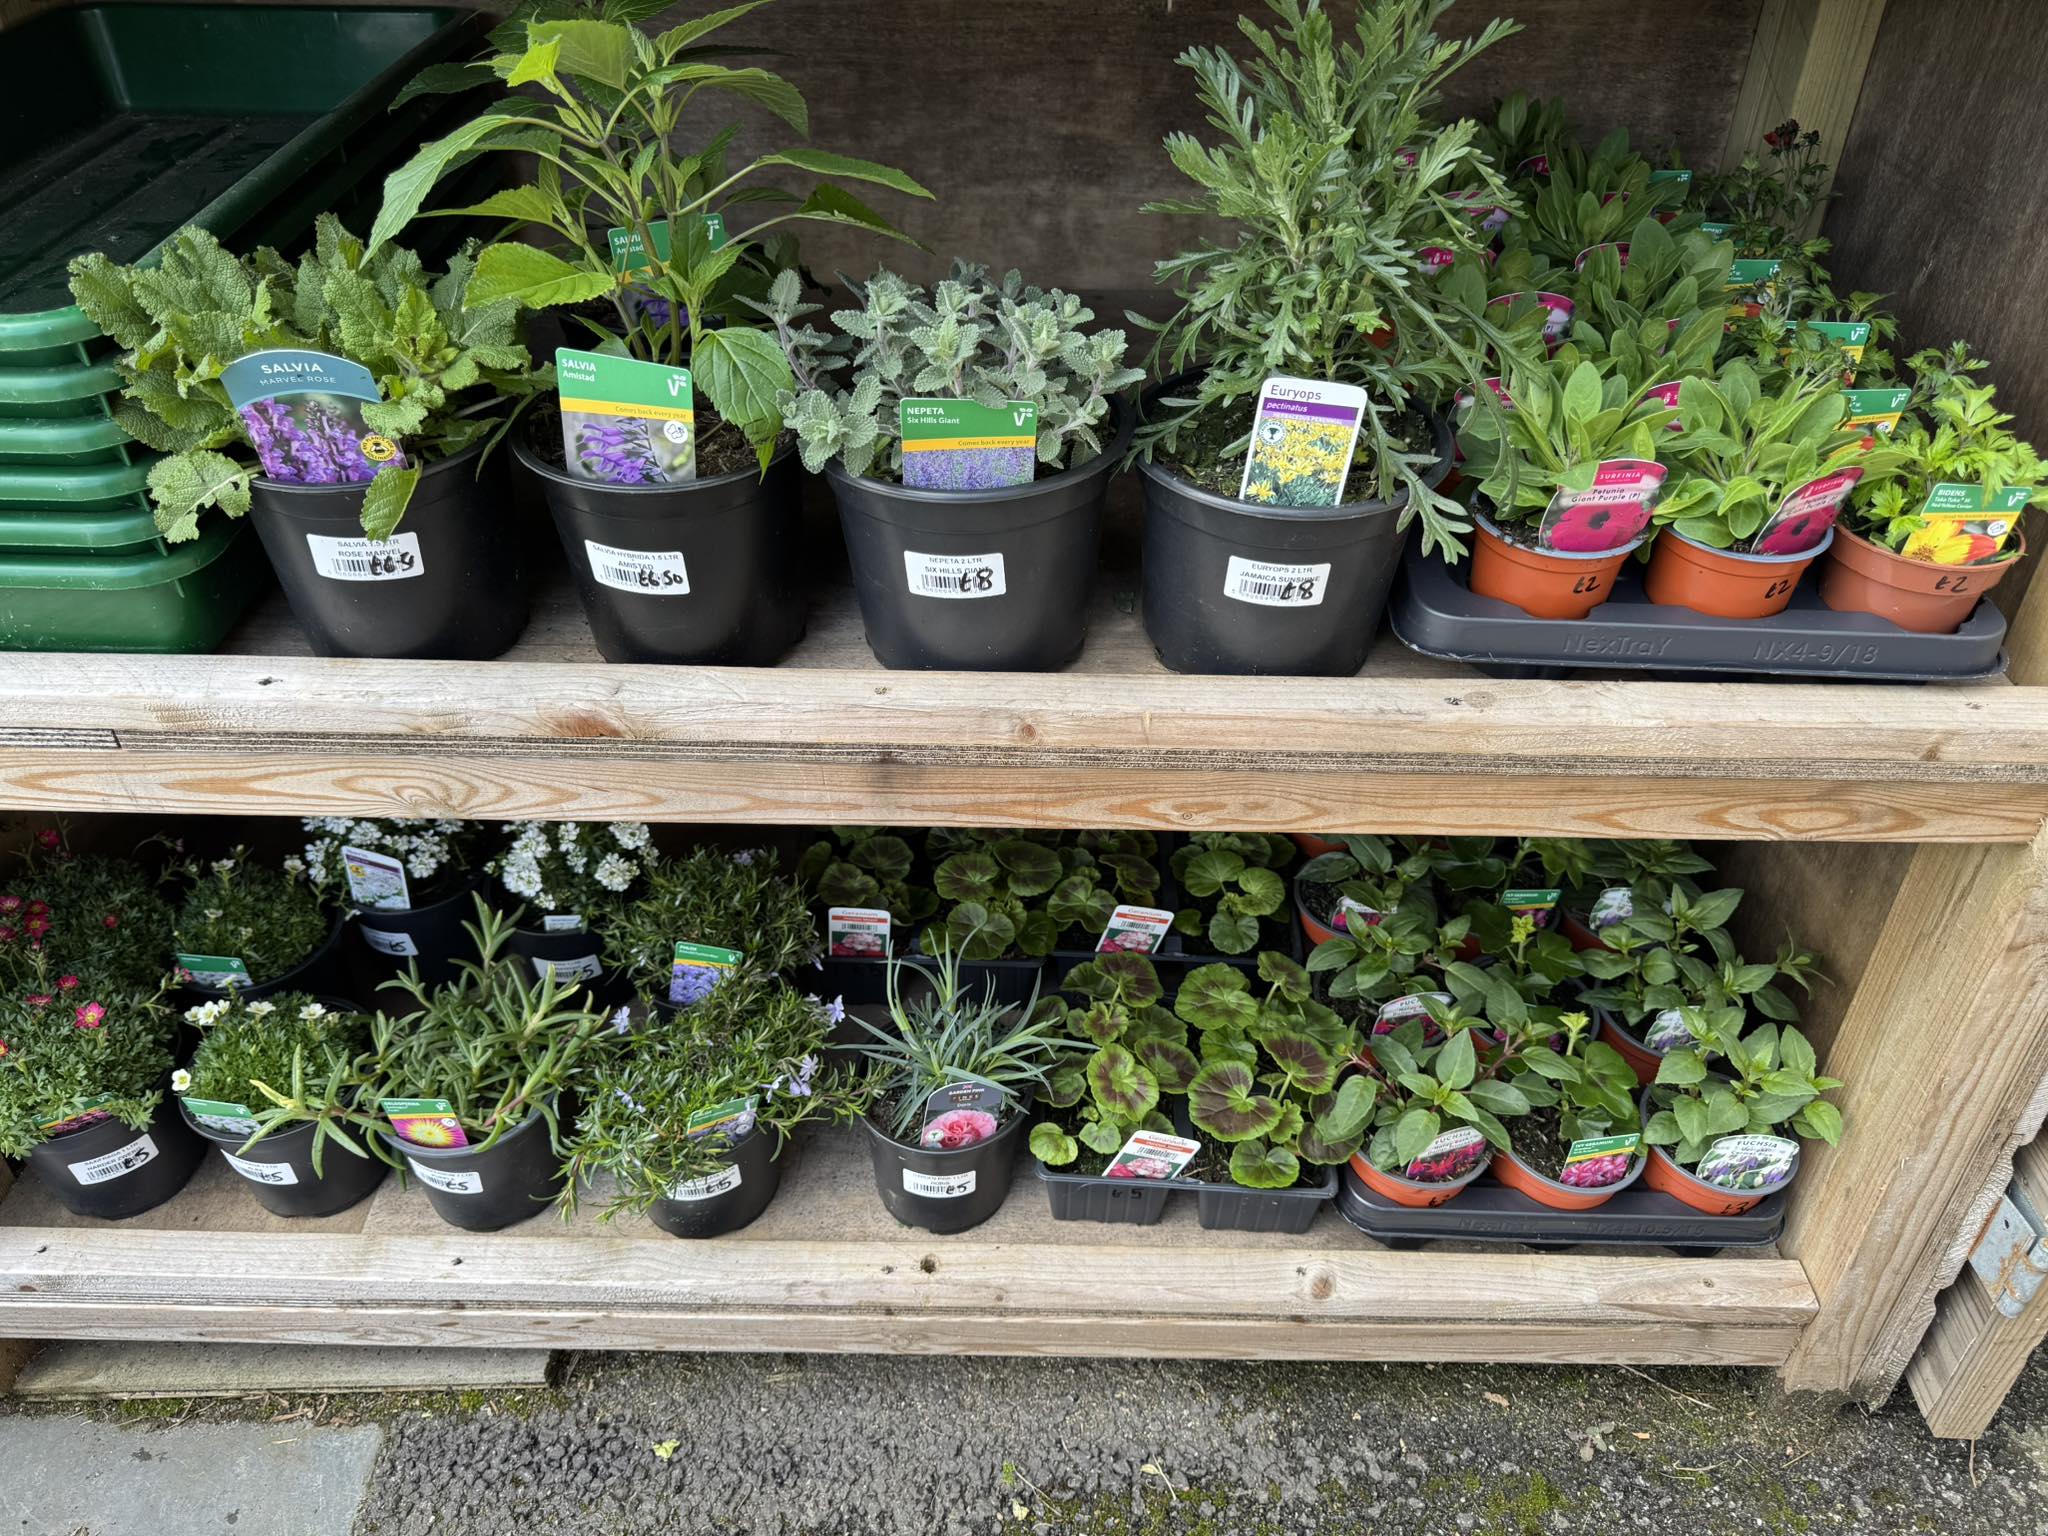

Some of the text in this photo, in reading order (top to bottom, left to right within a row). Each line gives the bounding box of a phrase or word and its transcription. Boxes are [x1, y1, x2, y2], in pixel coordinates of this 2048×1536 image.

[614, 232, 642, 246] SALVI
[261, 361, 324, 375] SALVIA
[561, 359, 596, 372] SALVIA
[259, 375, 337, 387] MARVEL ROSE
[562, 369, 596, 382] Amistad
[1270, 384, 1322, 401] Euryops
[615, 405, 687, 420] Comes back every year
[906, 407, 945, 415] NEPETA
[1266, 401, 1308, 413] pectinatus
[907, 416, 960, 425] Six Hills Giant
[1015, 438, 1030, 446] year
[1600, 471, 1641, 480] SURFINIA
[1593, 487, 1625, 495] Petunia
[1937, 488, 1966, 497] BIDENS
[1598, 494, 1626, 502] Purple
[1627, 492, 1641, 500] (P)
[337, 541, 369, 549] SALVIA
[370, 540, 382, 548] 1.5
[593, 544, 616, 556] SALVIA
[338, 547, 402, 558] ROSE MARVEL
[618, 560, 654, 570] AMISTAD
[928, 556, 960, 565] NEPETA
[967, 556, 983, 564] LTR
[924, 566, 938, 574] SIX
[939, 567, 963, 575] HILLS
[1251, 563, 1290, 573] EURYOPS
[1297, 566, 1313, 574] LTR
[1239, 571, 1321, 584] JAMAICA SUNSHINE
[1572, 575, 1601, 594] £2
[1934, 575, 1969, 593] £2
[1752, 638, 1881, 665] NX4-9/18
[1434, 1130, 1472, 1145] FUCHSIA
[1737, 1140, 1778, 1149] FUCHSIA
